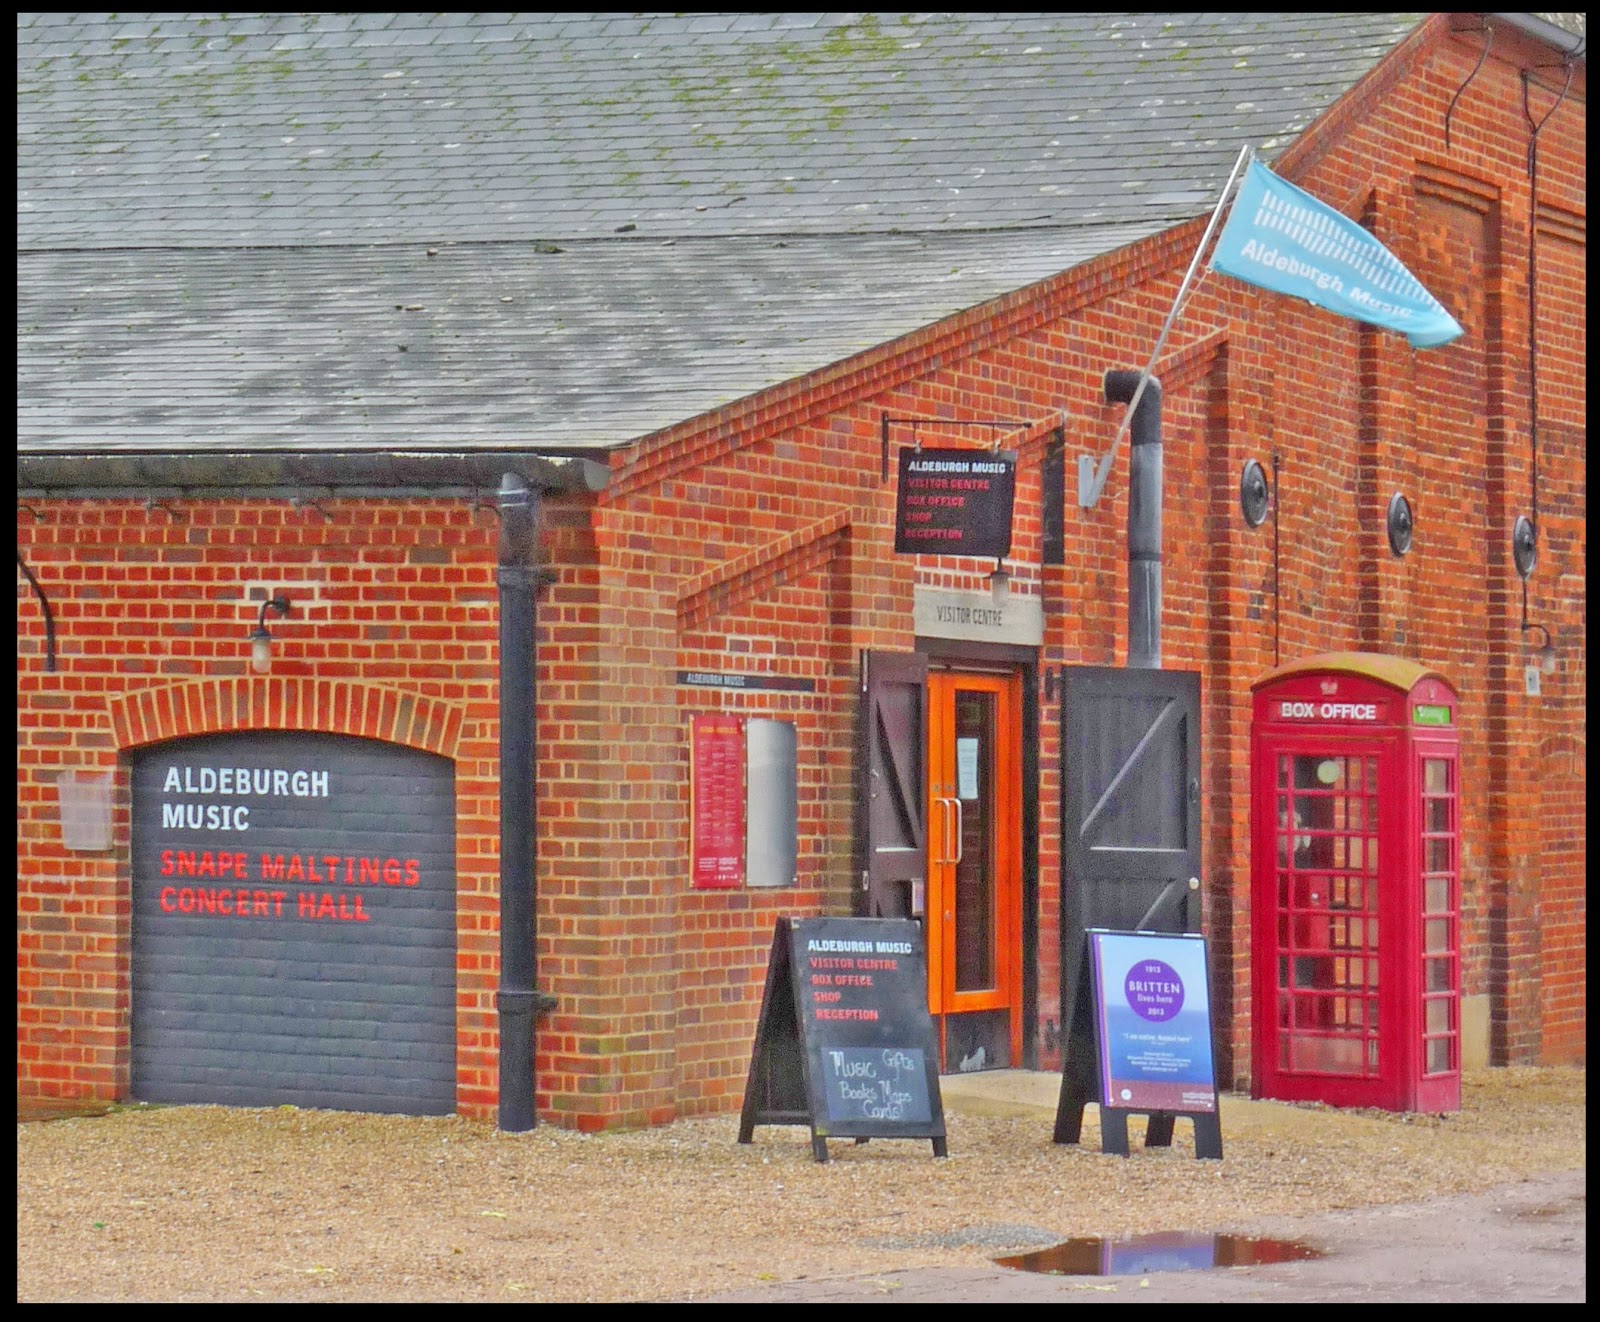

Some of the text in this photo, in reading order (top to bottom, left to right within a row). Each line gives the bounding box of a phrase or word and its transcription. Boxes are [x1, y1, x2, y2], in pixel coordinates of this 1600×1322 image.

[1241, 239, 1413, 318] Aldeburgh Music
[908, 461, 1006, 474] ALDEBURGH MUSIC
[936, 605, 1003, 627] VISITOR CENTRE
[1281, 702, 1376, 720] BOX OFFICE
[163, 766, 329, 797] ALDEBURGH
[162, 803, 250, 831] MUSIC
[160, 849, 420, 886] SNAPE MALTINGS
[159, 886, 371, 922] CONCERT HALL
[808, 939, 913, 954] ALDEBURGH MUSIC
[809, 957, 898, 970] VISITOR CENTRE
[811, 974, 873, 987] BOX OFFICE
[1129, 980, 1180, 994] BRITTEN
[813, 991, 841, 1002] SHOP
[815, 1009, 879, 1021] RECEPTION
[882, 1049, 915, 1081] Gifts
[839, 1081, 878, 1100] Books
[863, 1099, 902, 1119] Cards
